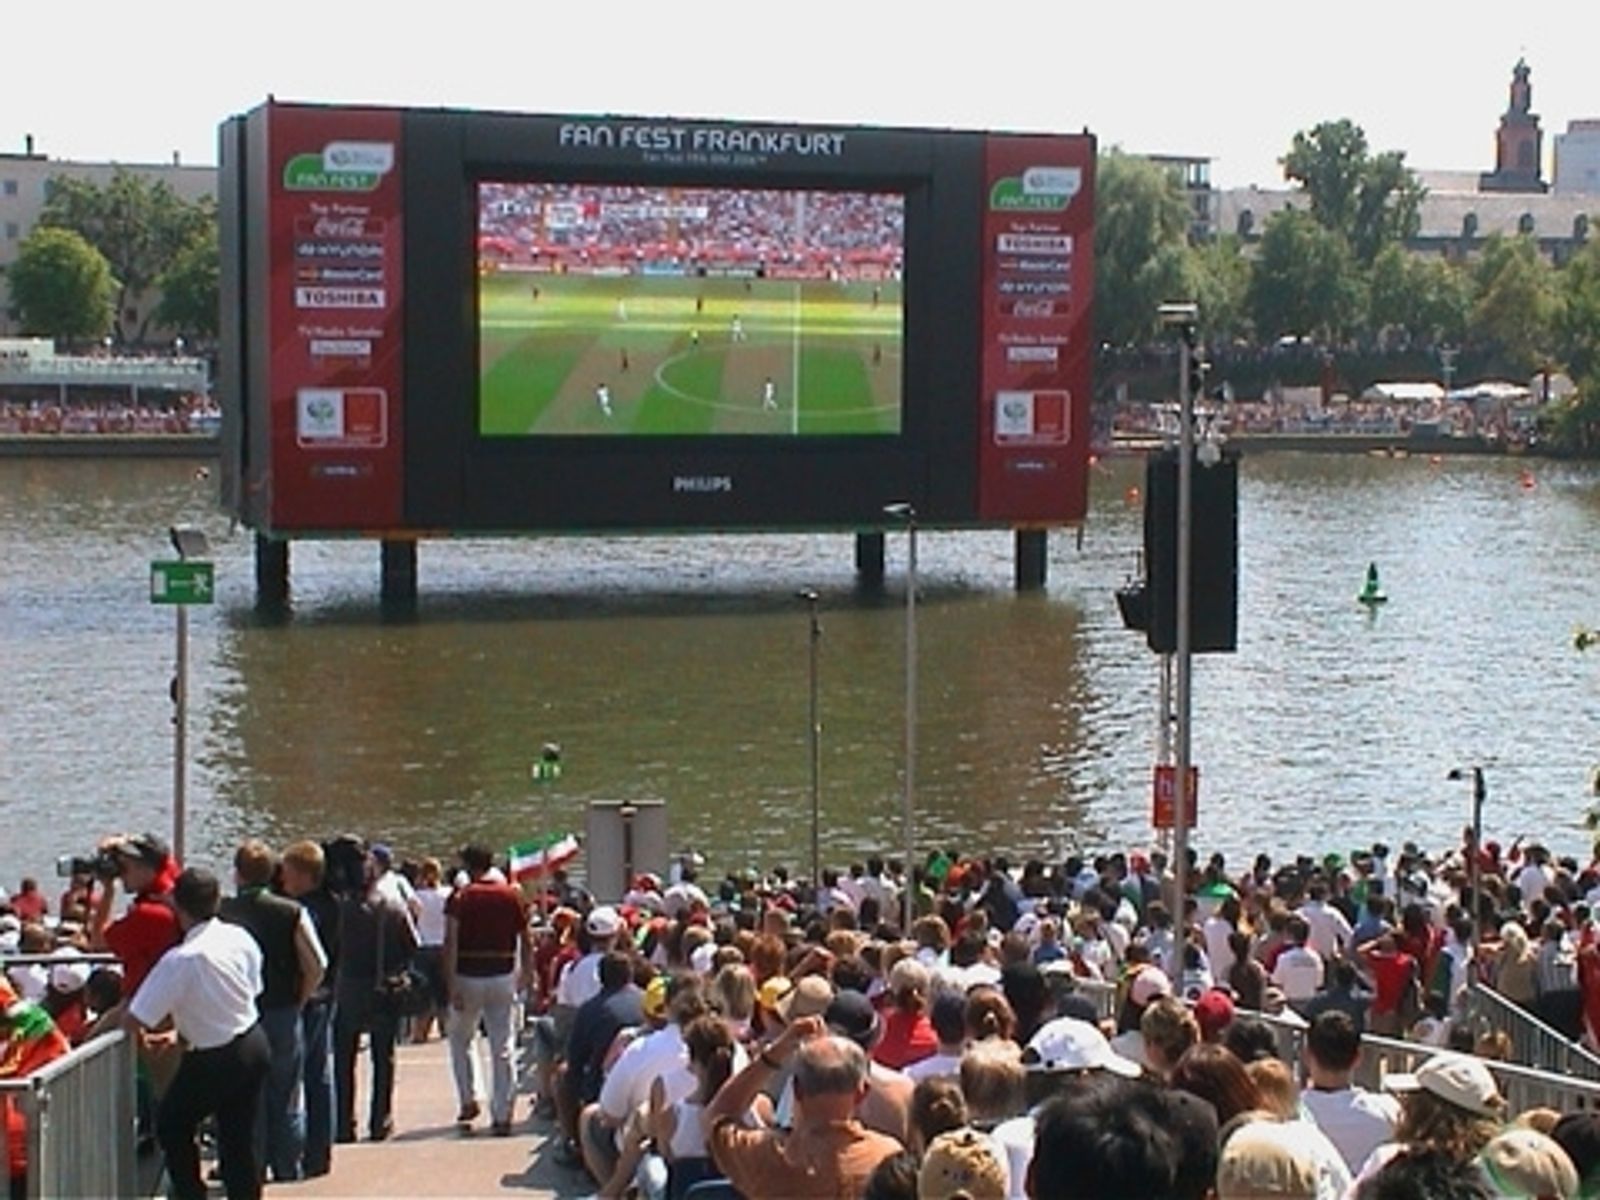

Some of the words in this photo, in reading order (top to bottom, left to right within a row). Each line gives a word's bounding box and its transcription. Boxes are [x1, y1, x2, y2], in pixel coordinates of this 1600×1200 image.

[560, 123, 613, 147] FAN
[619, 125, 686, 150] FEST
[693, 128, 846, 155] FRANKFURT
[1004, 238, 1067, 249] TOSHIBA
[303, 289, 378, 305] TOSHIBA
[673, 476, 732, 492] PHILIPS
